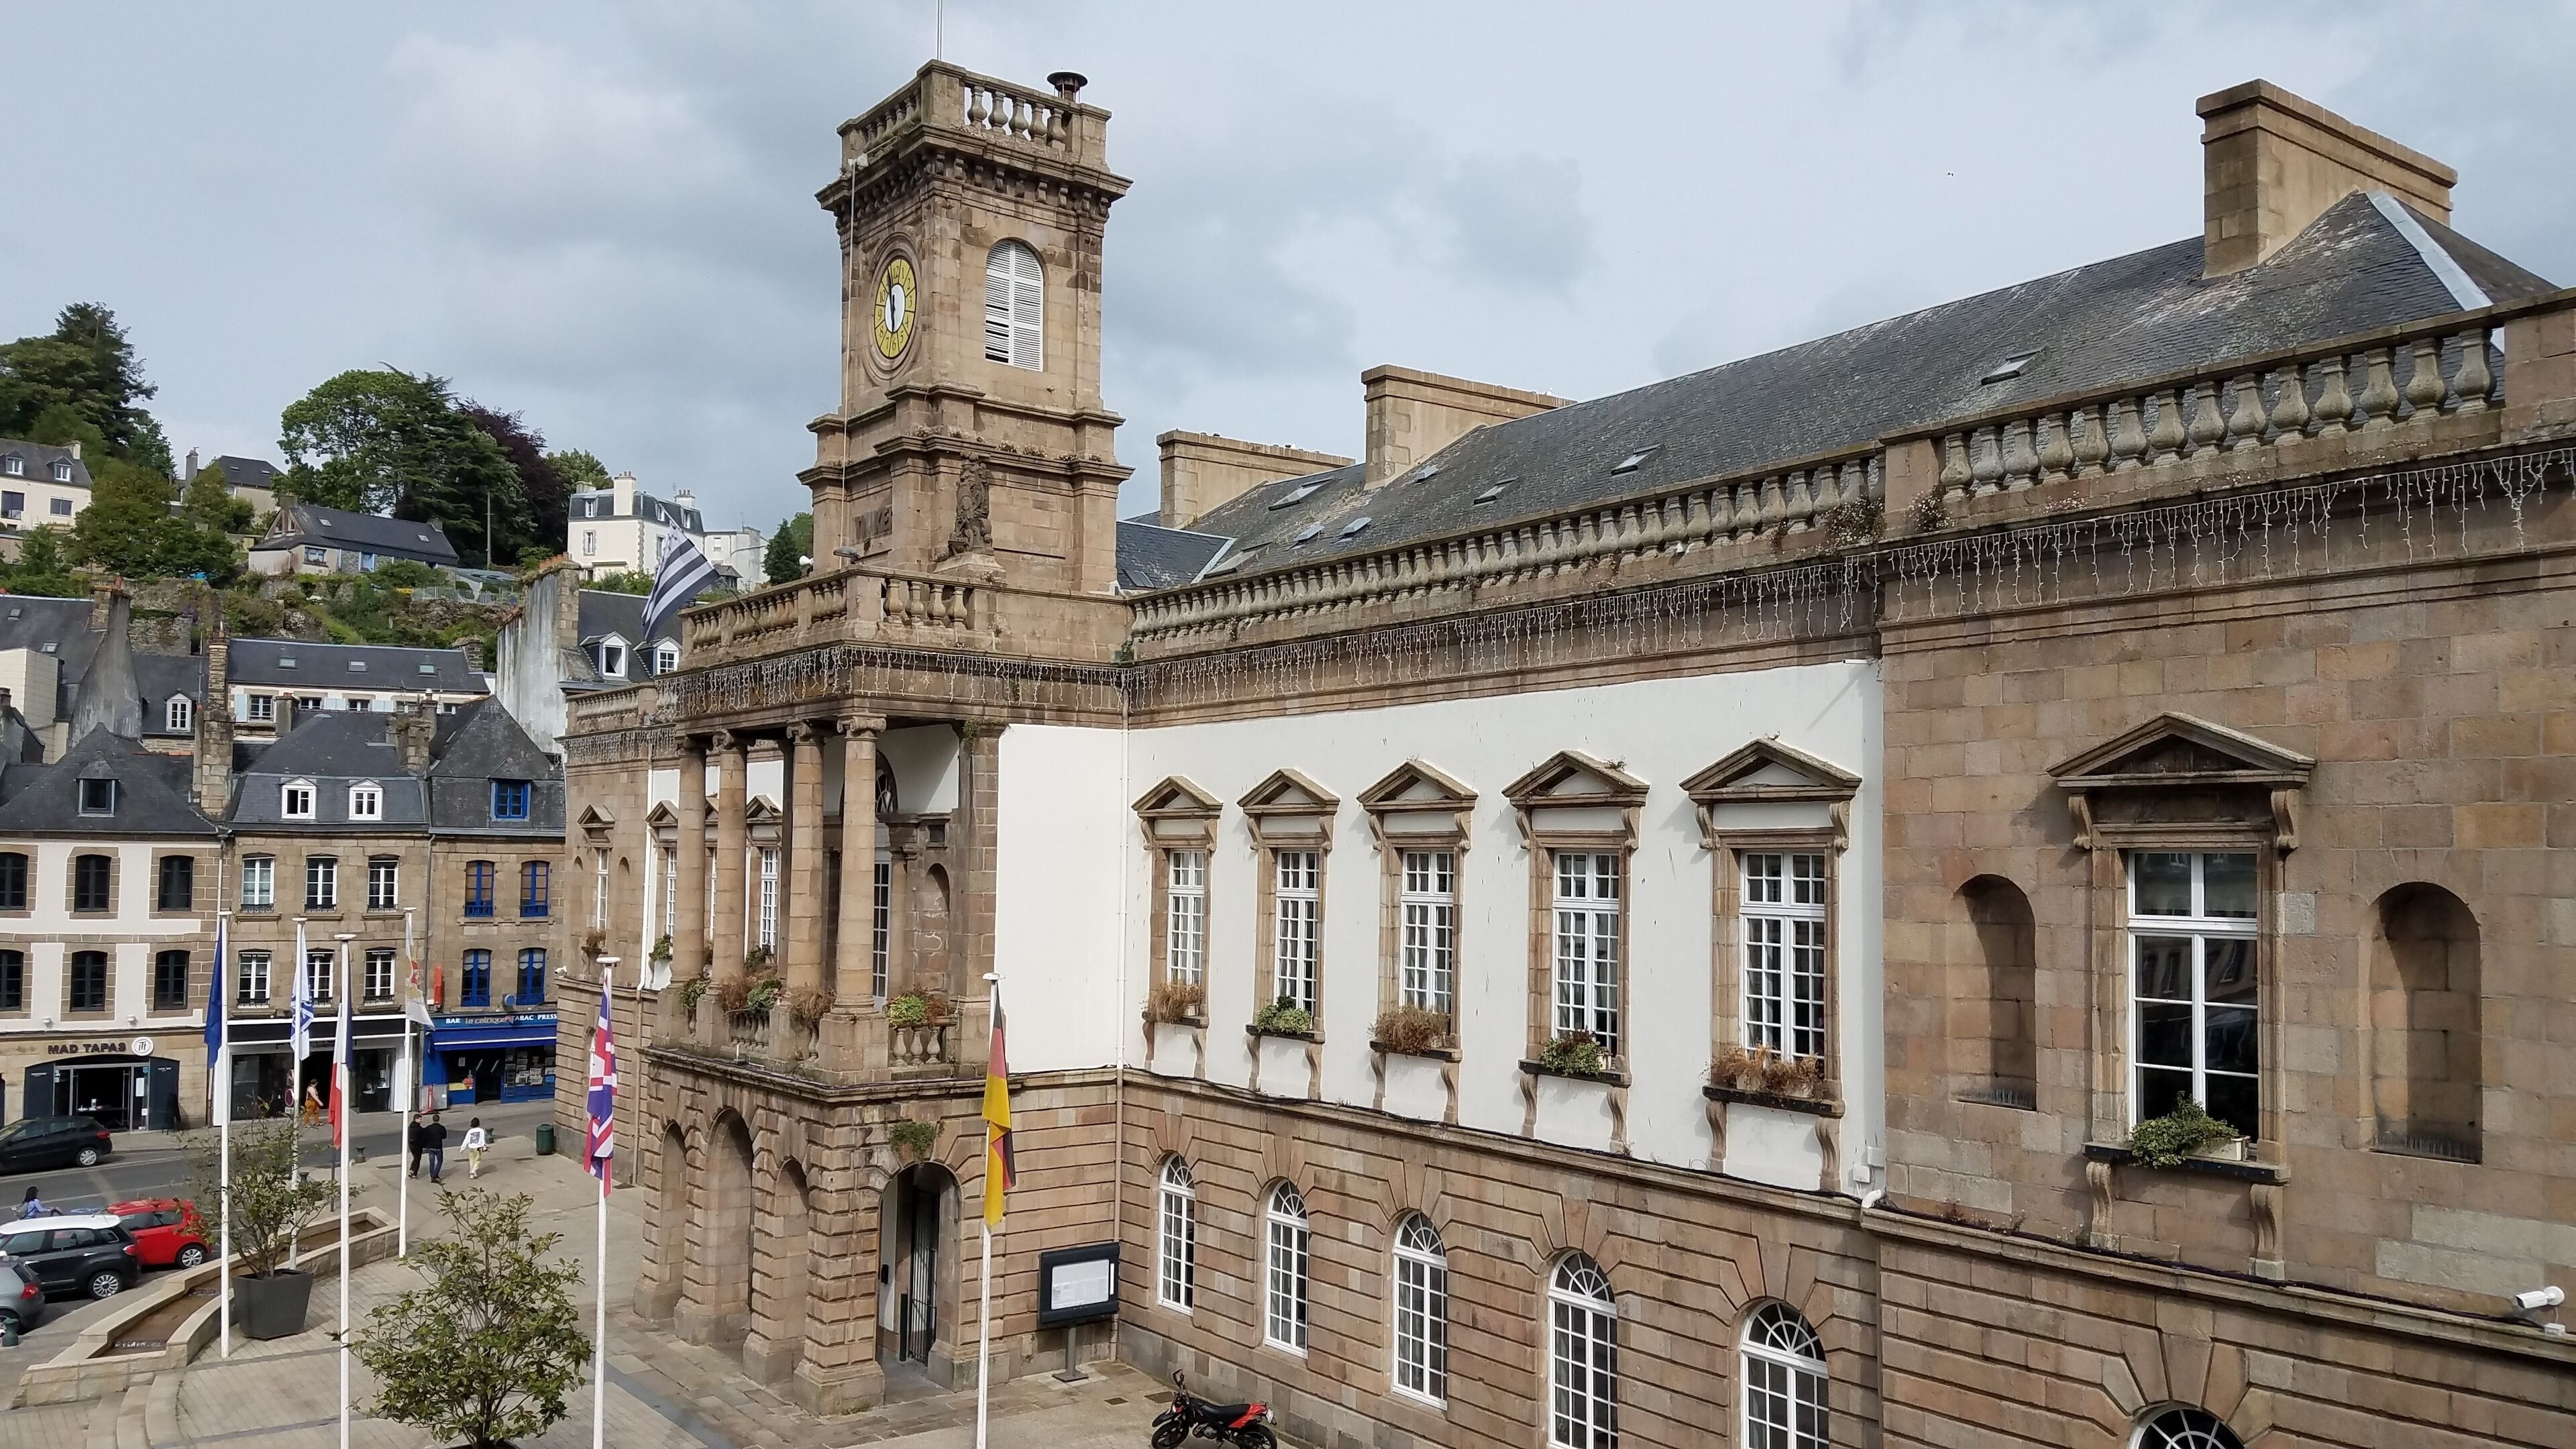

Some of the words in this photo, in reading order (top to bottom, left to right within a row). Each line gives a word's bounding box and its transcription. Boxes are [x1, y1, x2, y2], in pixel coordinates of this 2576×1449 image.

[893, 265, 899, 279] 12
[902, 267, 905, 279] 1
[906, 278, 911, 290] 2
[879, 289, 885, 303] 10
[908, 294, 912, 308] 3
[877, 309, 882, 321] 9
[904, 315, 909, 328] 4
[879, 325, 884, 338] 8
[900, 330, 904, 343] 5
[885, 337, 890, 350] 7
[892, 337, 896, 351] 6
[48, 1044, 78, 1055] MAD
[83, 1042, 127, 1053] TAPAS
